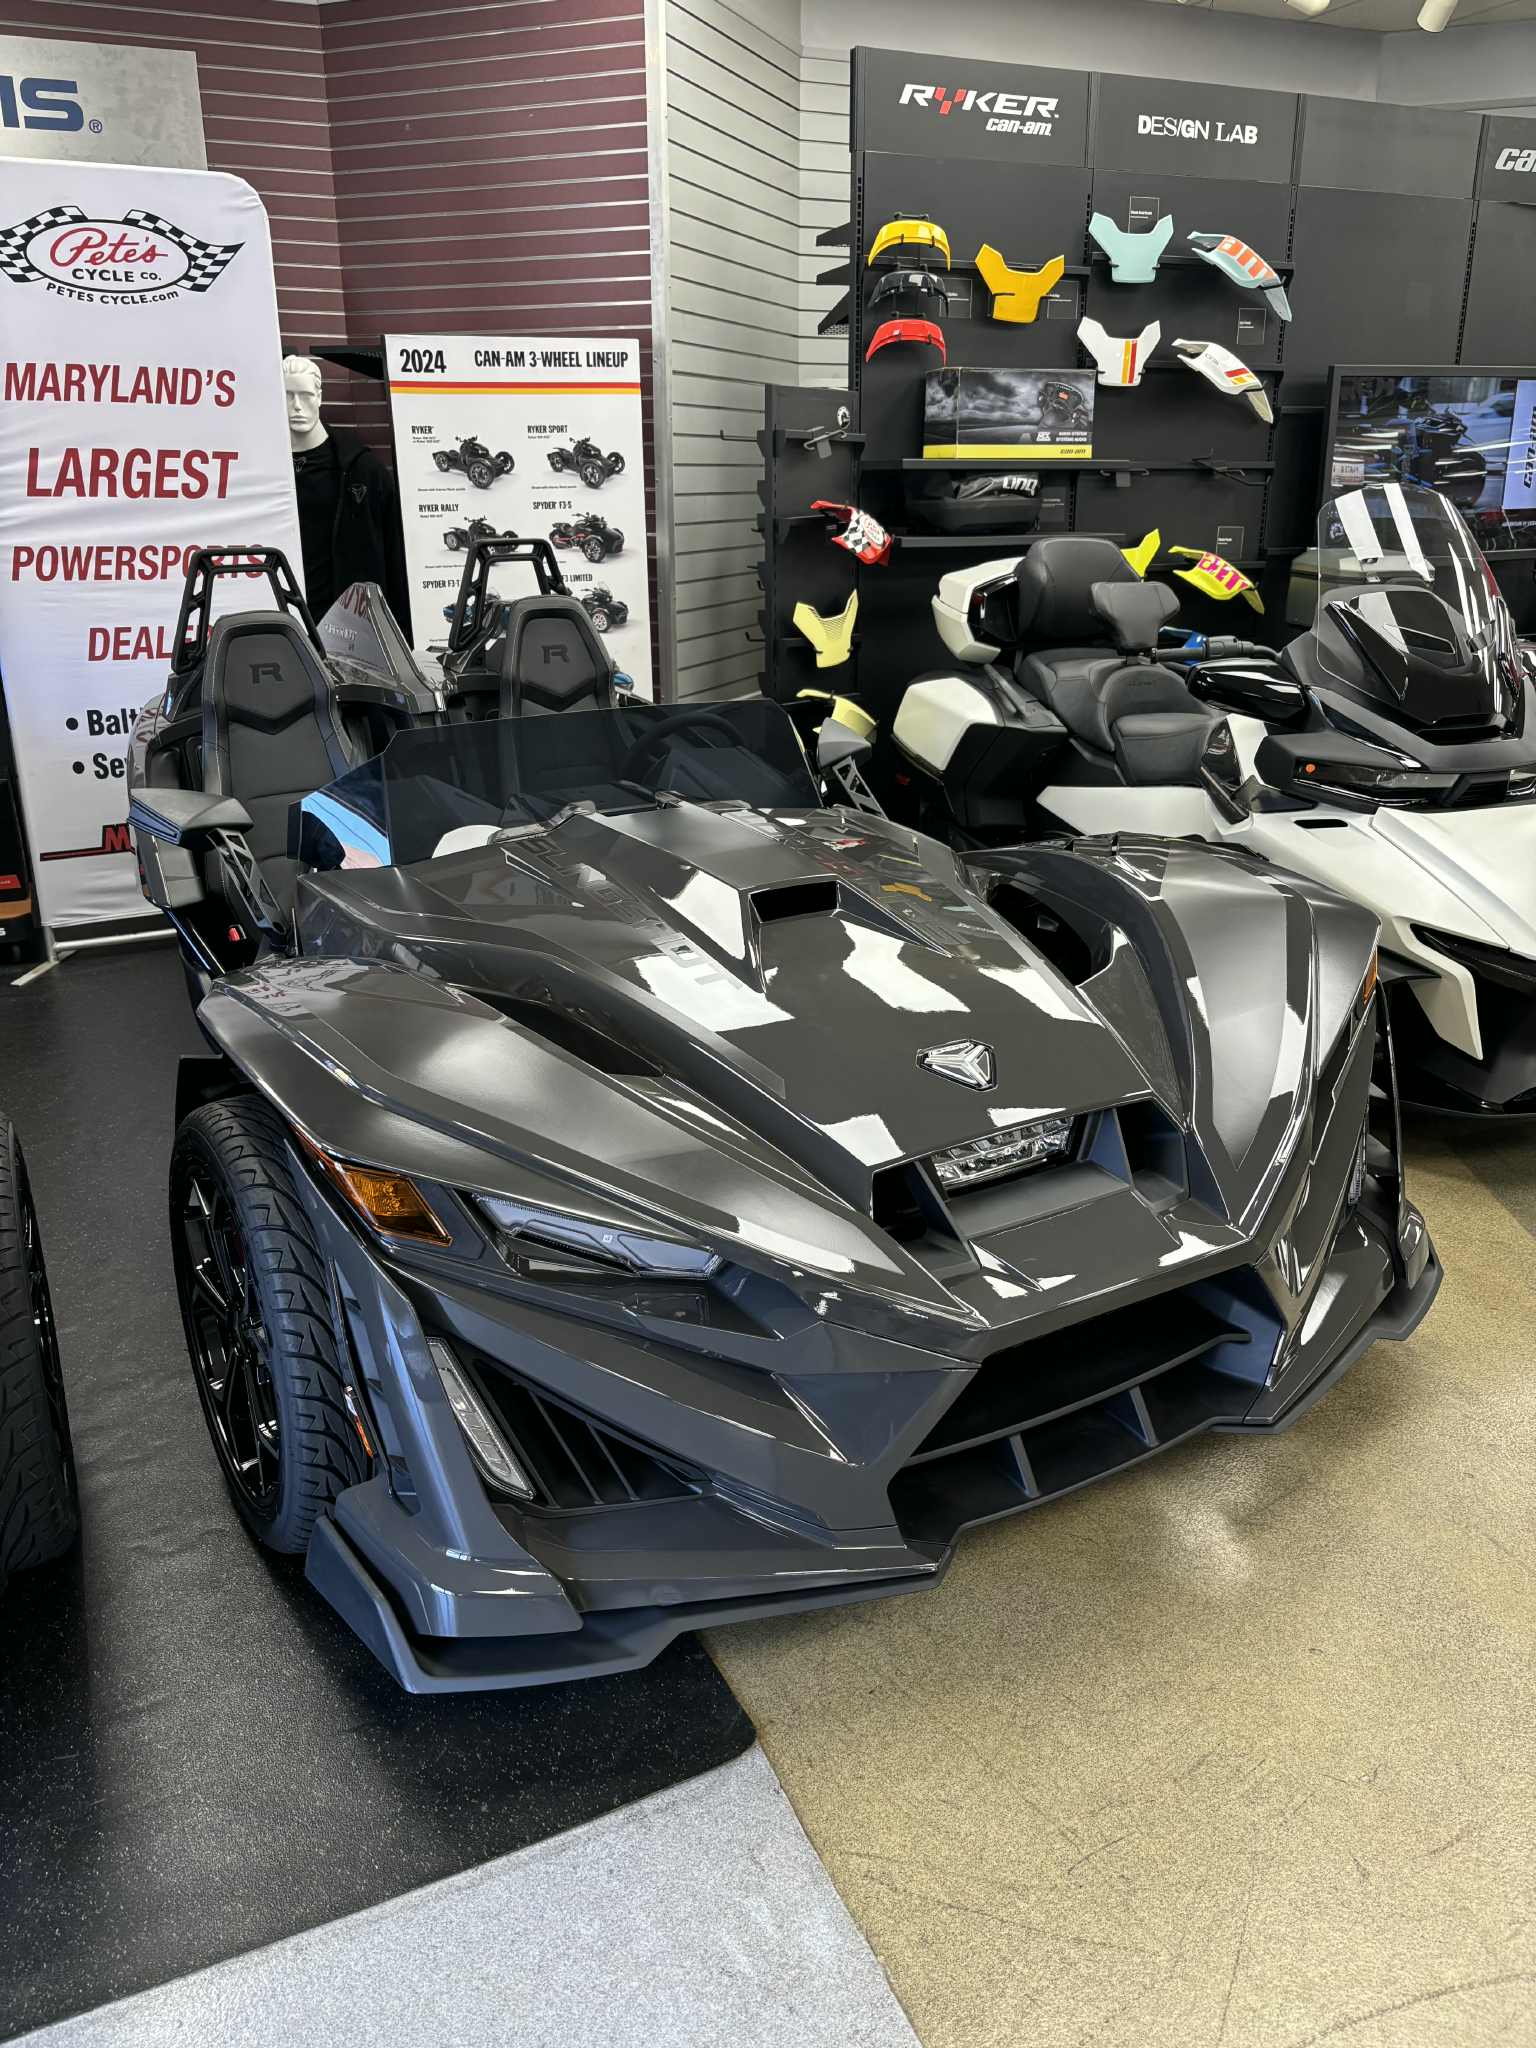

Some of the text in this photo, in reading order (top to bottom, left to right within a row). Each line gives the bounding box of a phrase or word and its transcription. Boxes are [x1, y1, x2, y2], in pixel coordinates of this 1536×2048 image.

[898, 83, 1060, 121] RYKER
[985, 117, 1052, 136] can-am
[1137, 115, 1259, 144] DESIGN LAB
[1495, 147, 1536, 172] ca
[50, 227, 168, 267] Pete's
[72, 268, 162, 282] CYCLE CO.
[46, 282, 94, 303] PETES
[400, 349, 629, 373] 2024 CAN-AM 3-WHEEL LINEUP
[4, 362, 236, 407] MARYLAND'S
[411, 426, 432, 434] RYKER
[527, 425, 568, 434] RYKER SPORT
[26, 448, 239, 499] LARGEST
[418, 503, 459, 513] RYKER RALLY
[532, 501, 556, 510] SPYDER
[422, 580, 446, 589] SPYDER
[570, 574, 592, 582] LIMITED
